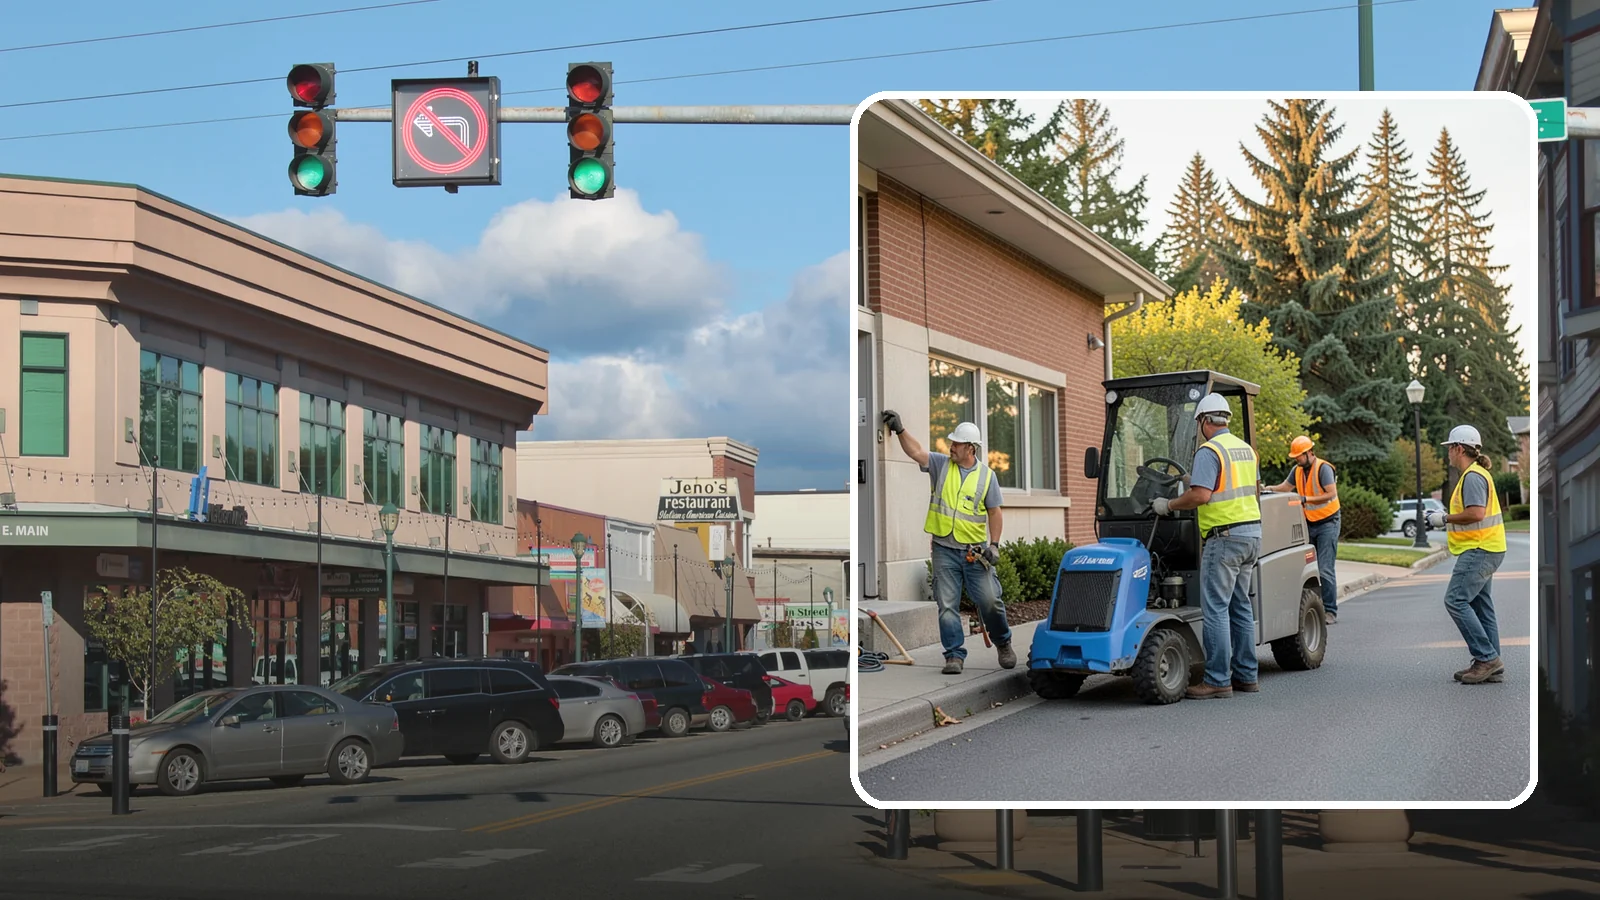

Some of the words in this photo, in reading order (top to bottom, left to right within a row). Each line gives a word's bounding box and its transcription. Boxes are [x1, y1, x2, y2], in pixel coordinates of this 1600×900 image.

[669, 479, 728, 494] Jeno's
[665, 497, 731, 509] restaurant
[658, 509, 682, 520] Italian
[686, 509, 714, 520] American
[715, 509, 738, 519] Cuisine
[2, 525, 13, 536] E.
[15, 525, 49, 536] MAIN
[797, 607, 828, 617] Street
[791, 618, 824, 627] lass
